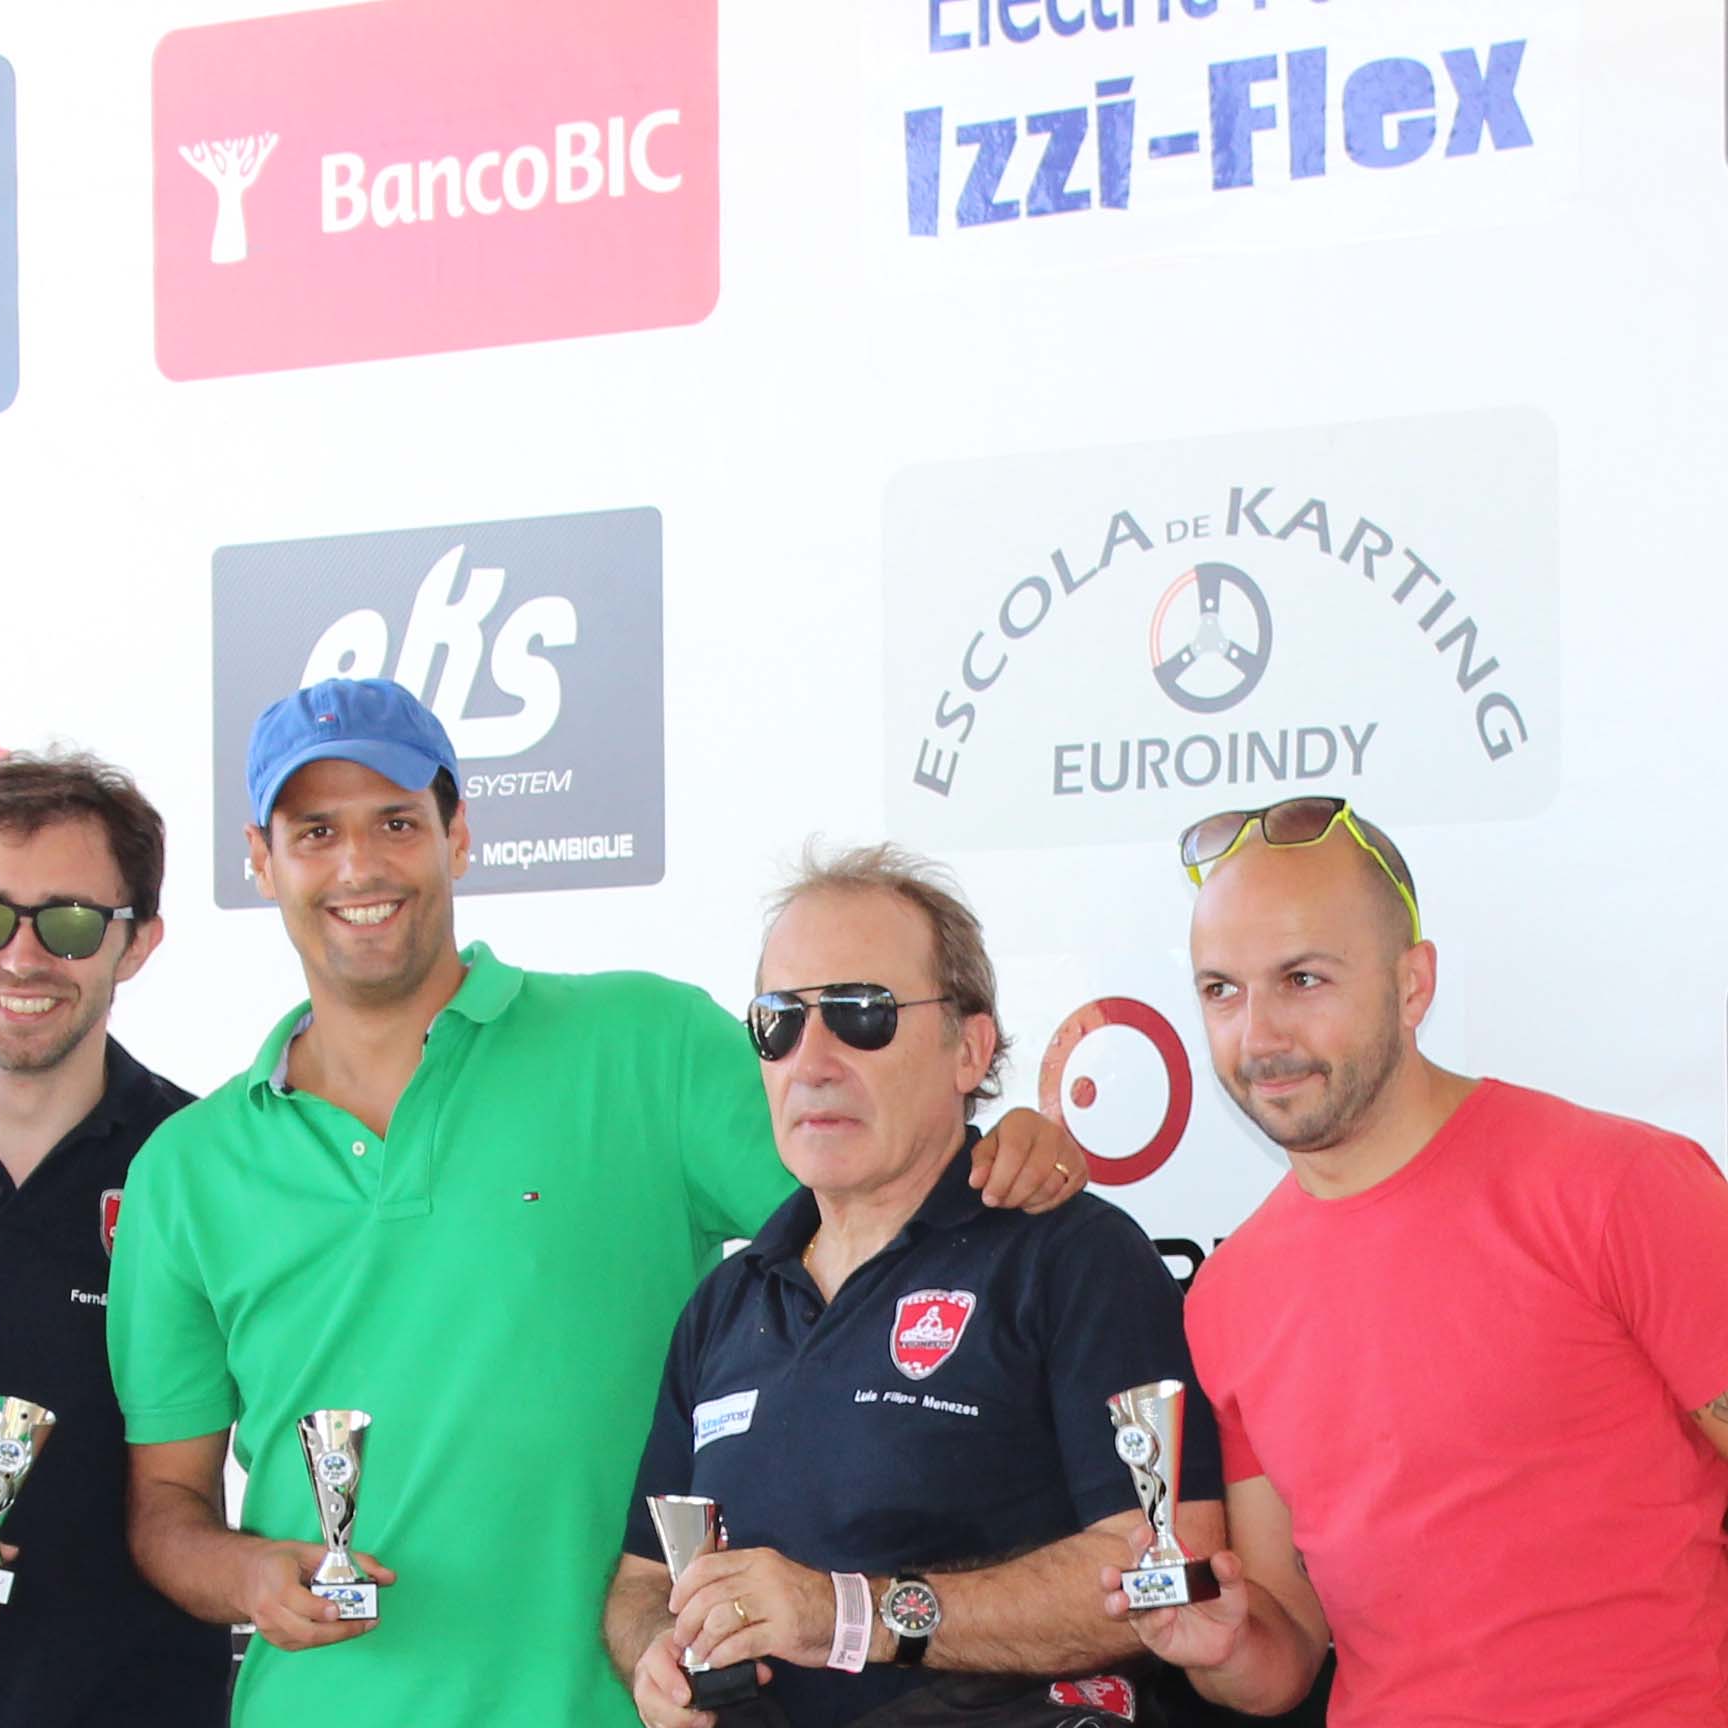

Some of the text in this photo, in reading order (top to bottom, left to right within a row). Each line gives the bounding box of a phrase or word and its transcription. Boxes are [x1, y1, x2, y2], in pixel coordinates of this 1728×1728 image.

[321, 109, 682, 232] BancoBIC
[904, 39, 1533, 237] Izzi-Flex
[913, 486, 1528, 797] ESCOLA DE KARTING
[466, 770, 572, 797] SYSTEM
[1052, 722, 1378, 795] EUROINDY
[483, 835, 634, 869] MOÇAMBIQUE
[922, 1395, 979, 1416] Menezes
